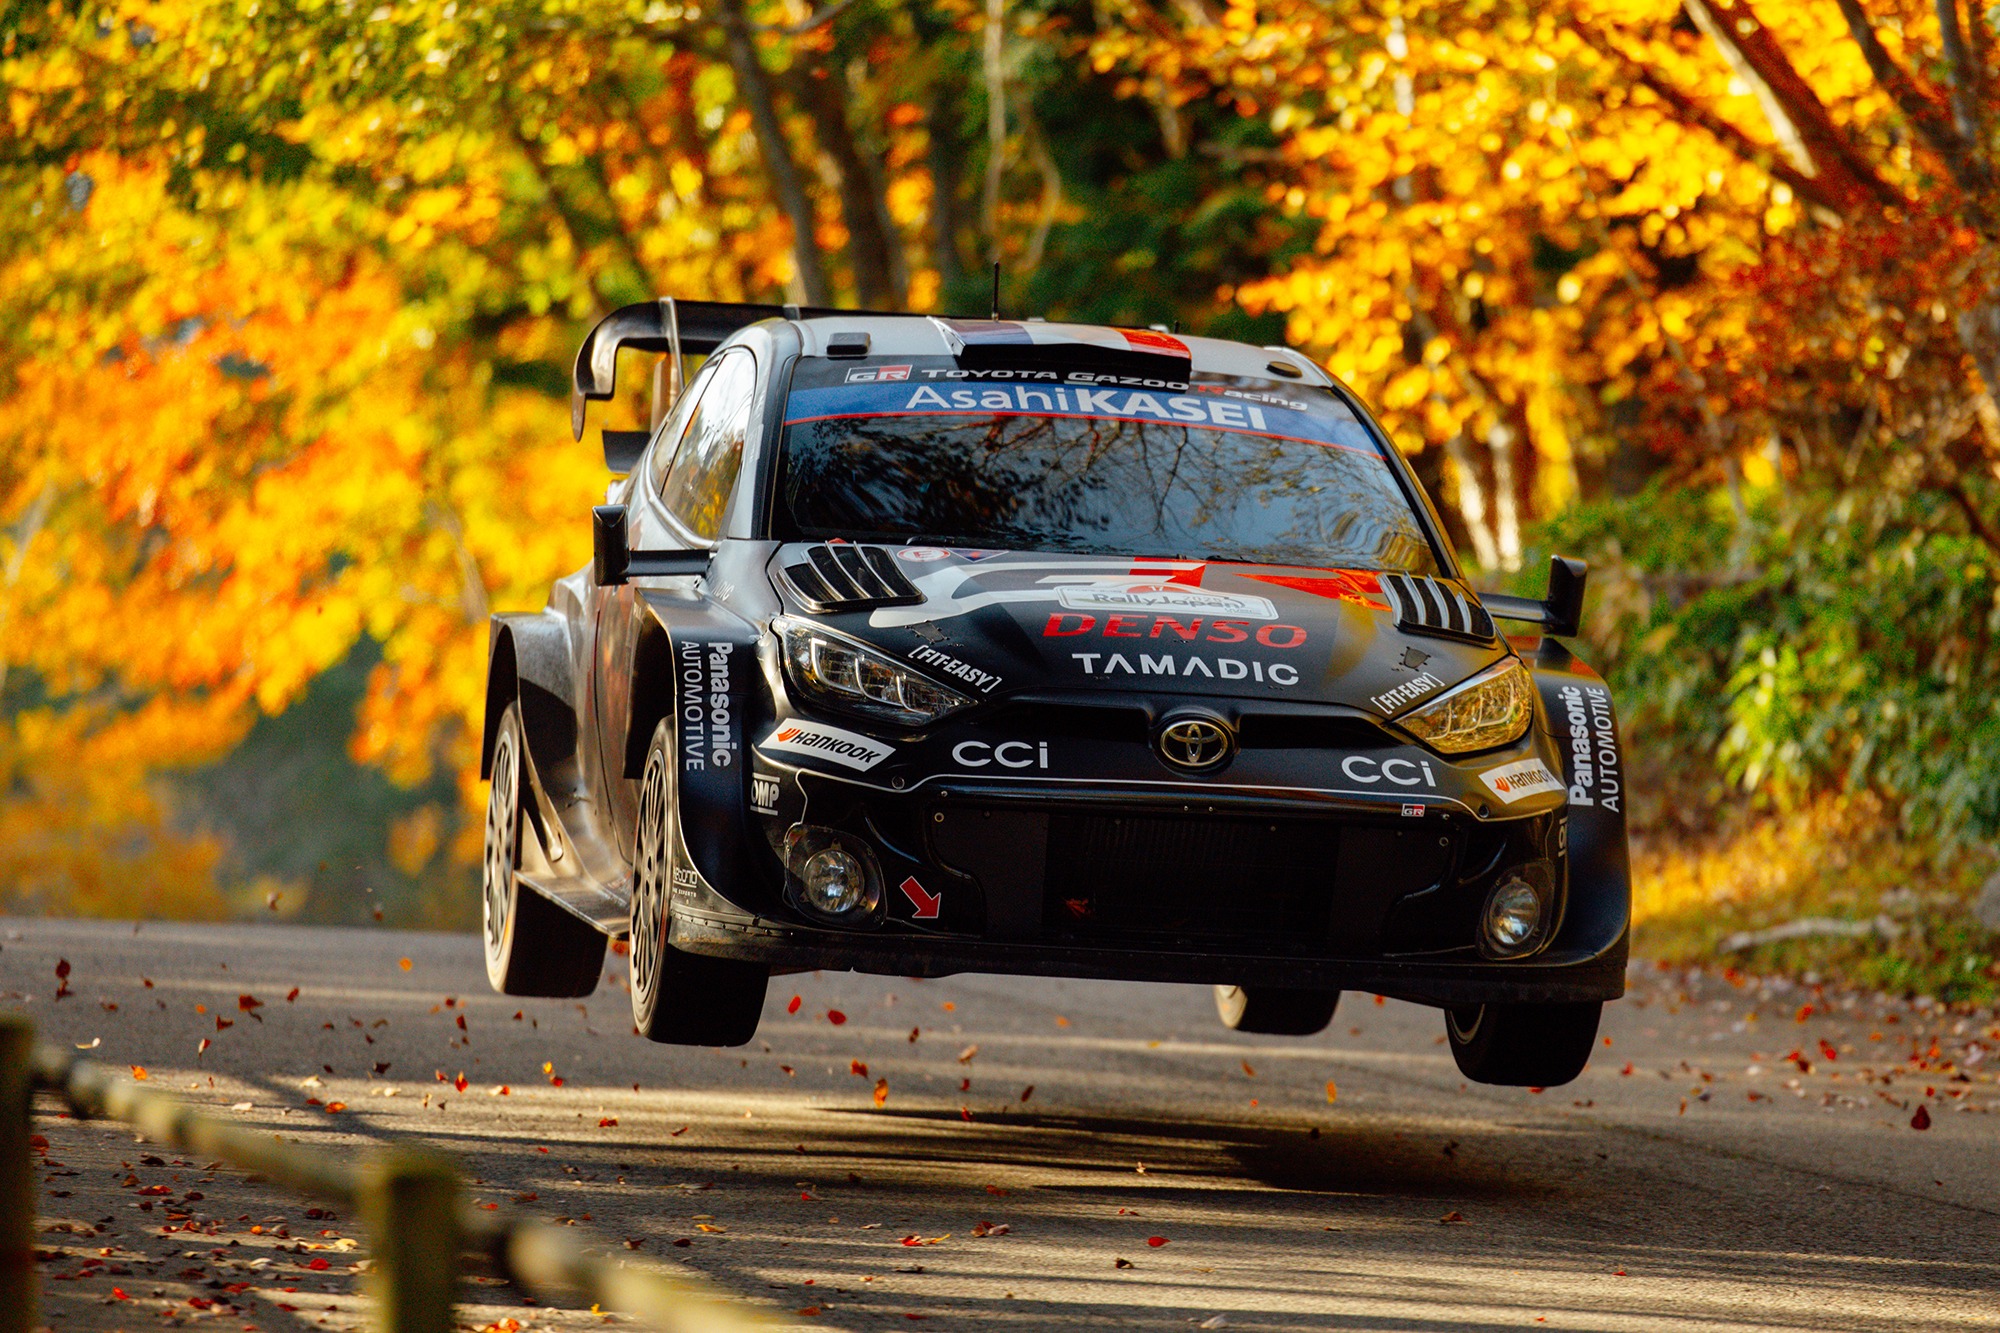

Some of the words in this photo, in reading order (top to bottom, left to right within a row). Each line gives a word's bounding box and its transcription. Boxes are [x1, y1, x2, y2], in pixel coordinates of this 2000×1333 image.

[850, 370, 907, 381] GR
[921, 369, 1057, 379] TOYOTA
[1067, 372, 1189, 390] GAZOO
[1197, 385, 1308, 411] Racing
[1043, 612, 1307, 648] DENSO
[1072, 653, 1299, 686] TAMADIC
[681, 640, 704, 771] AUTOMOTIVE
[708, 642, 737, 767] Panasonic
[1558, 686, 1594, 806] Panasonic
[1586, 687, 1619, 813] AUTOMOTIVE
[751, 780, 779, 808] OMP
